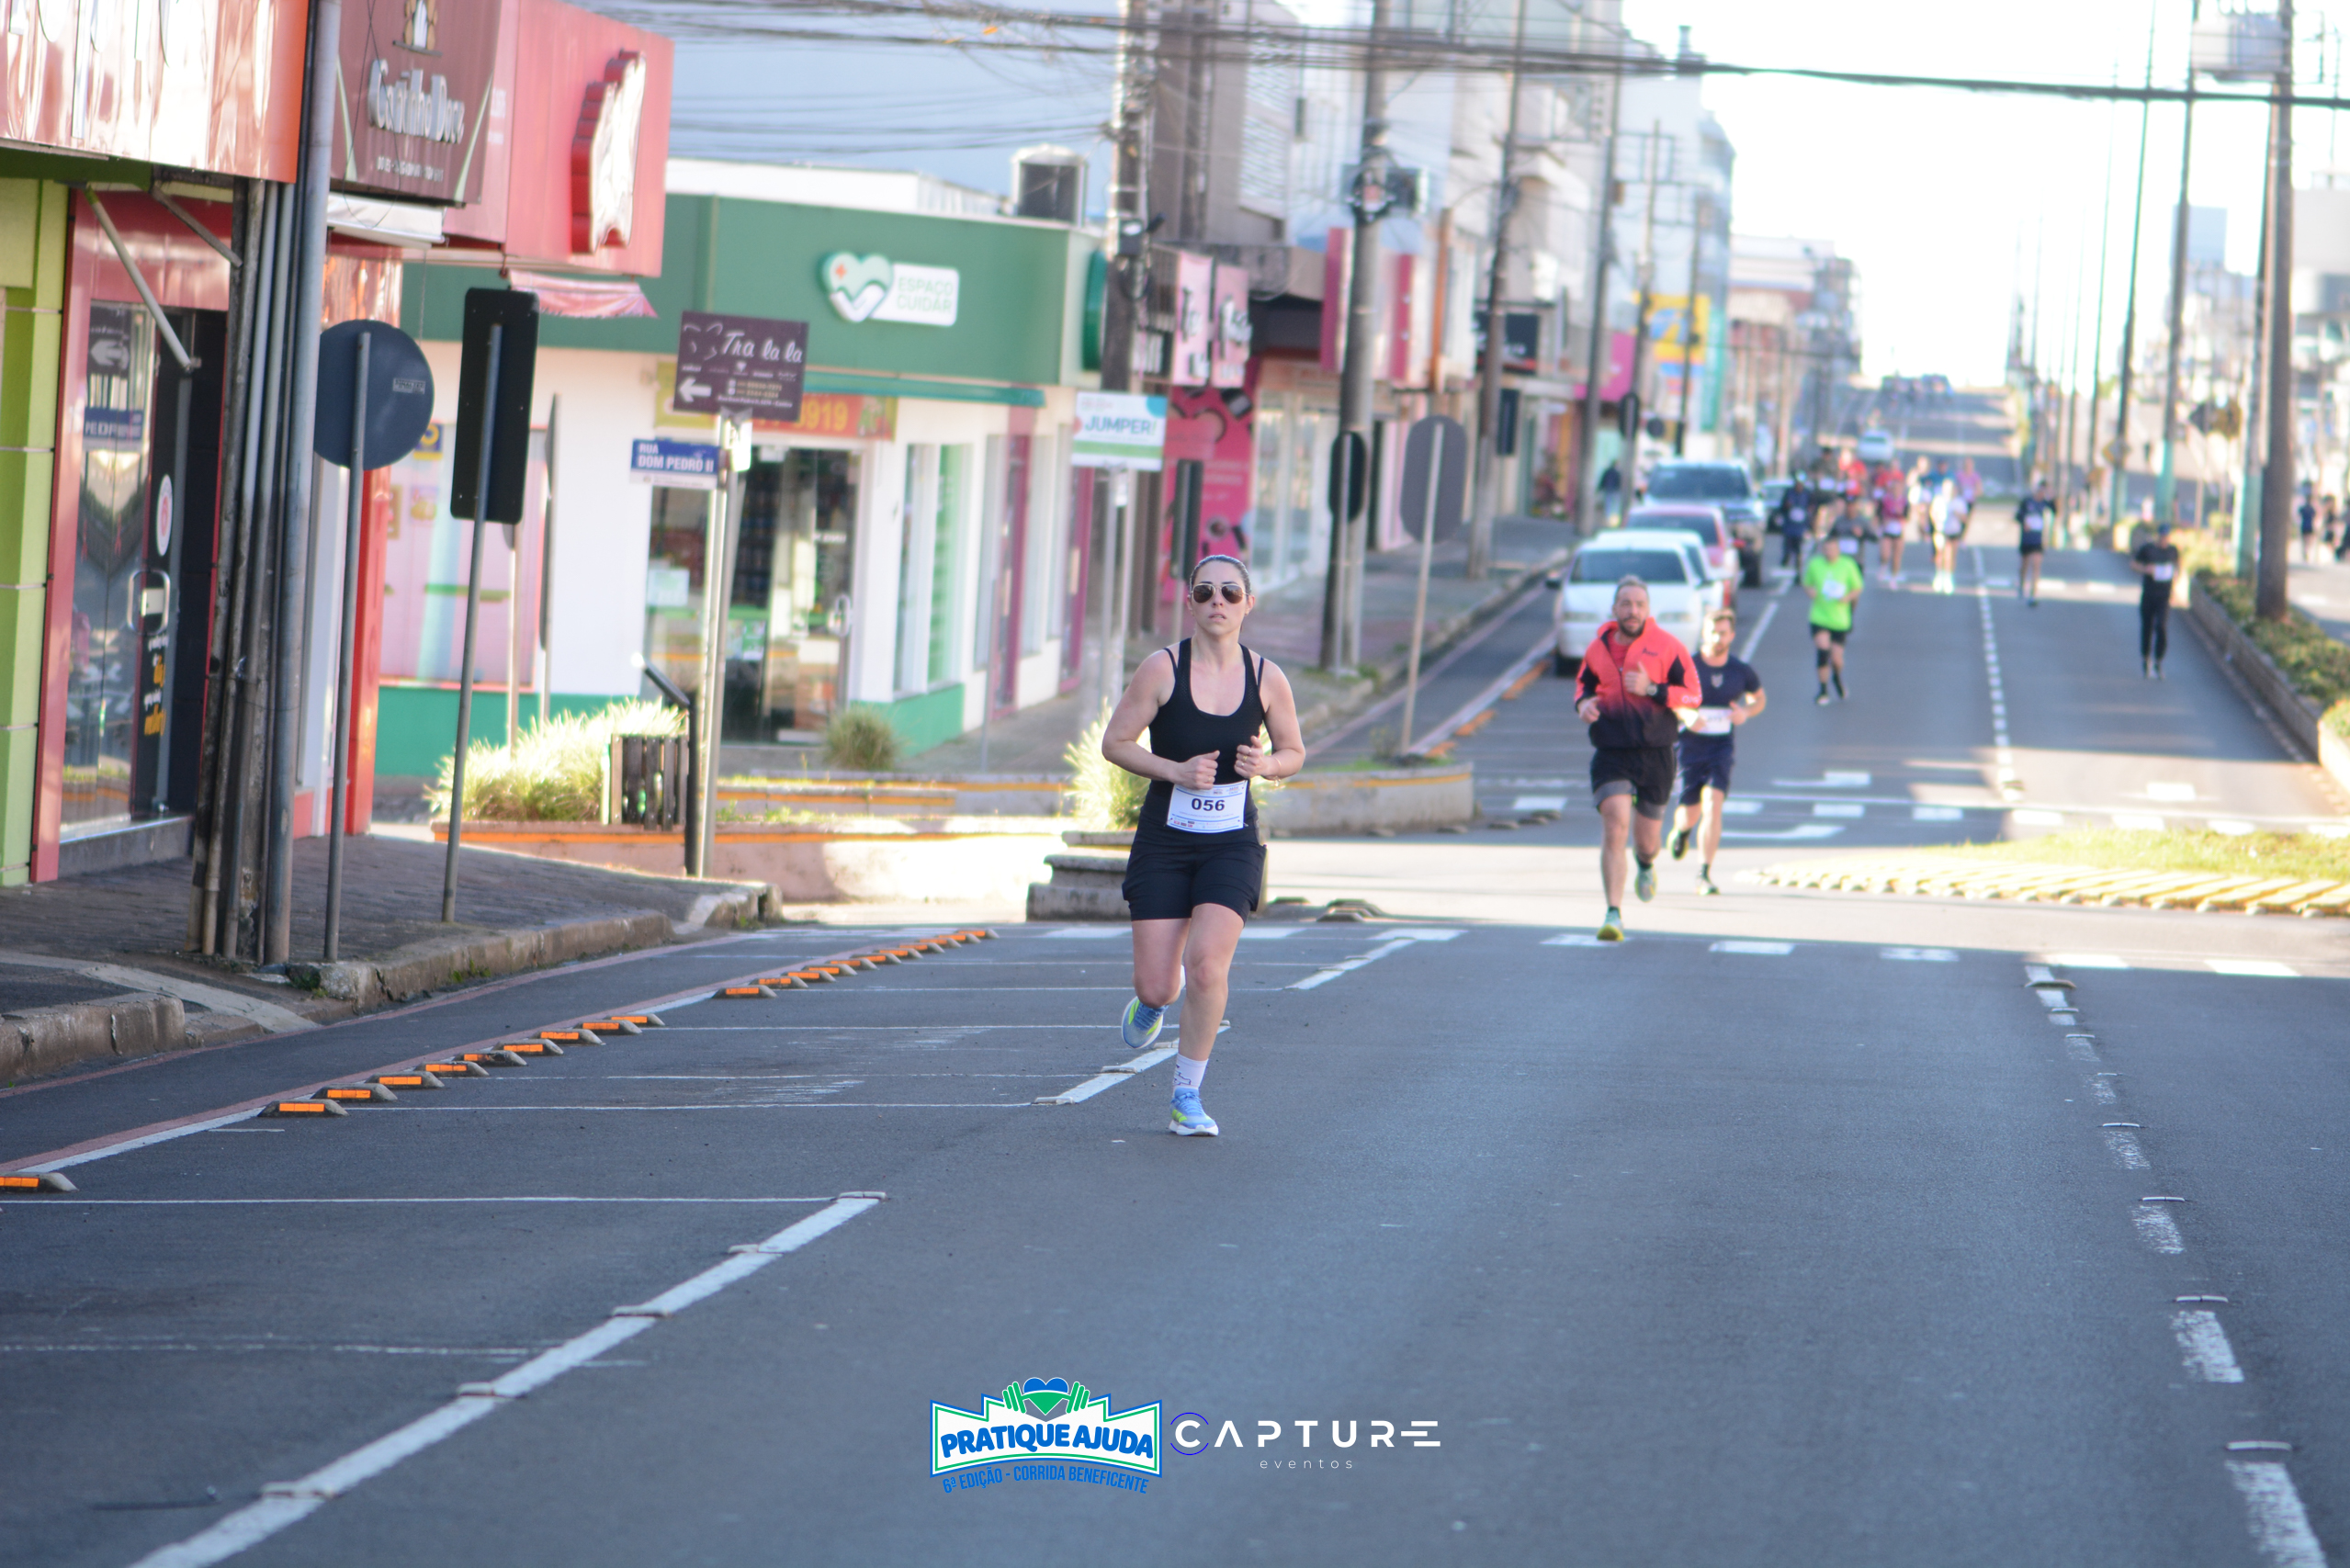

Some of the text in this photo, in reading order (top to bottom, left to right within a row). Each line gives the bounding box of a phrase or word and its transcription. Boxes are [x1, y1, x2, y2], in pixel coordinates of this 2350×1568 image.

[898, 277, 954, 296] ESPAÇO
[898, 295, 953, 313] CUIDAR
[722, 332, 803, 364] Tra la la
[1085, 415, 1158, 436] JUMPER!
[638, 443, 660, 455] RUA
[638, 455, 715, 473] DOM PEDRO II
[1192, 797, 1226, 812] 056
